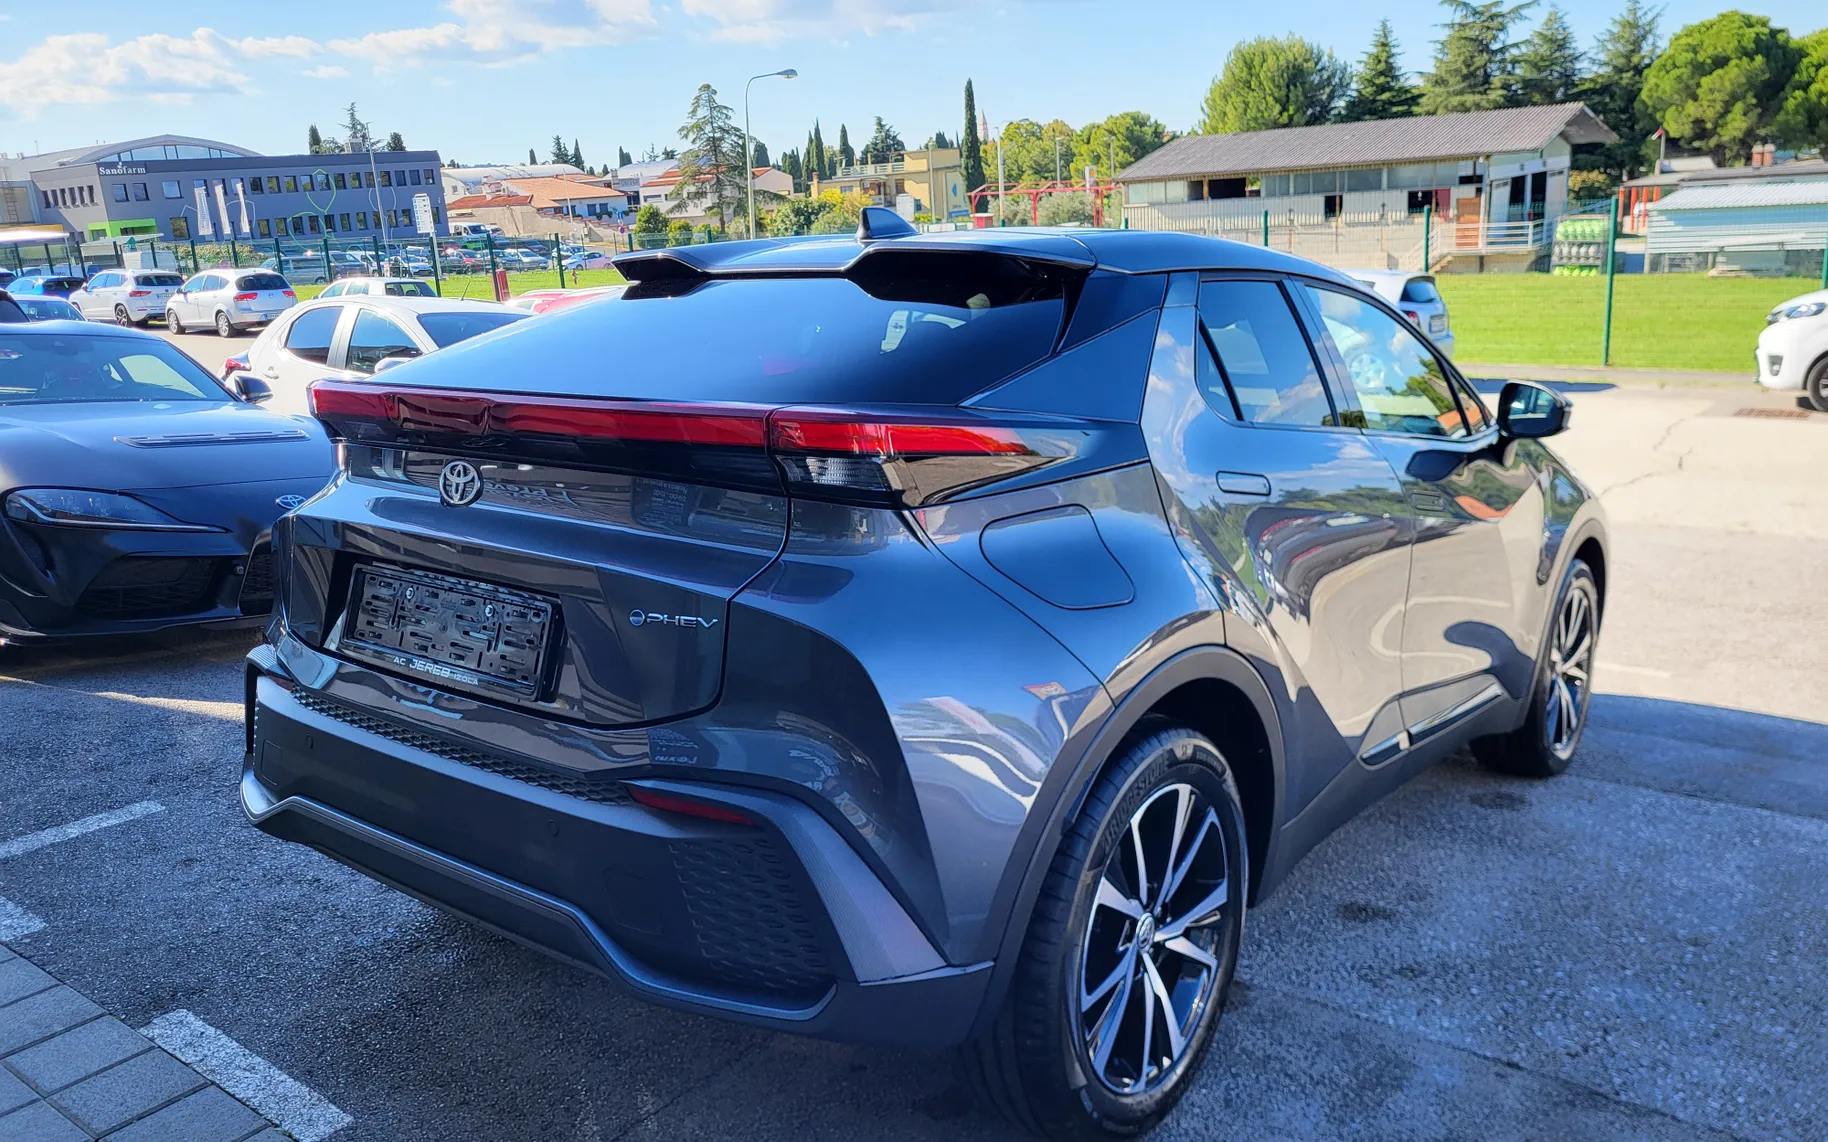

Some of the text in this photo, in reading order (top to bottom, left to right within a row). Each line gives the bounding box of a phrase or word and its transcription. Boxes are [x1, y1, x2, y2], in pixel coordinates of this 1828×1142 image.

[99, 166, 146, 175] Sanofarm
[647, 613, 718, 628] PHEV
[393, 656, 479, 686] AC JEREB IZOLA
